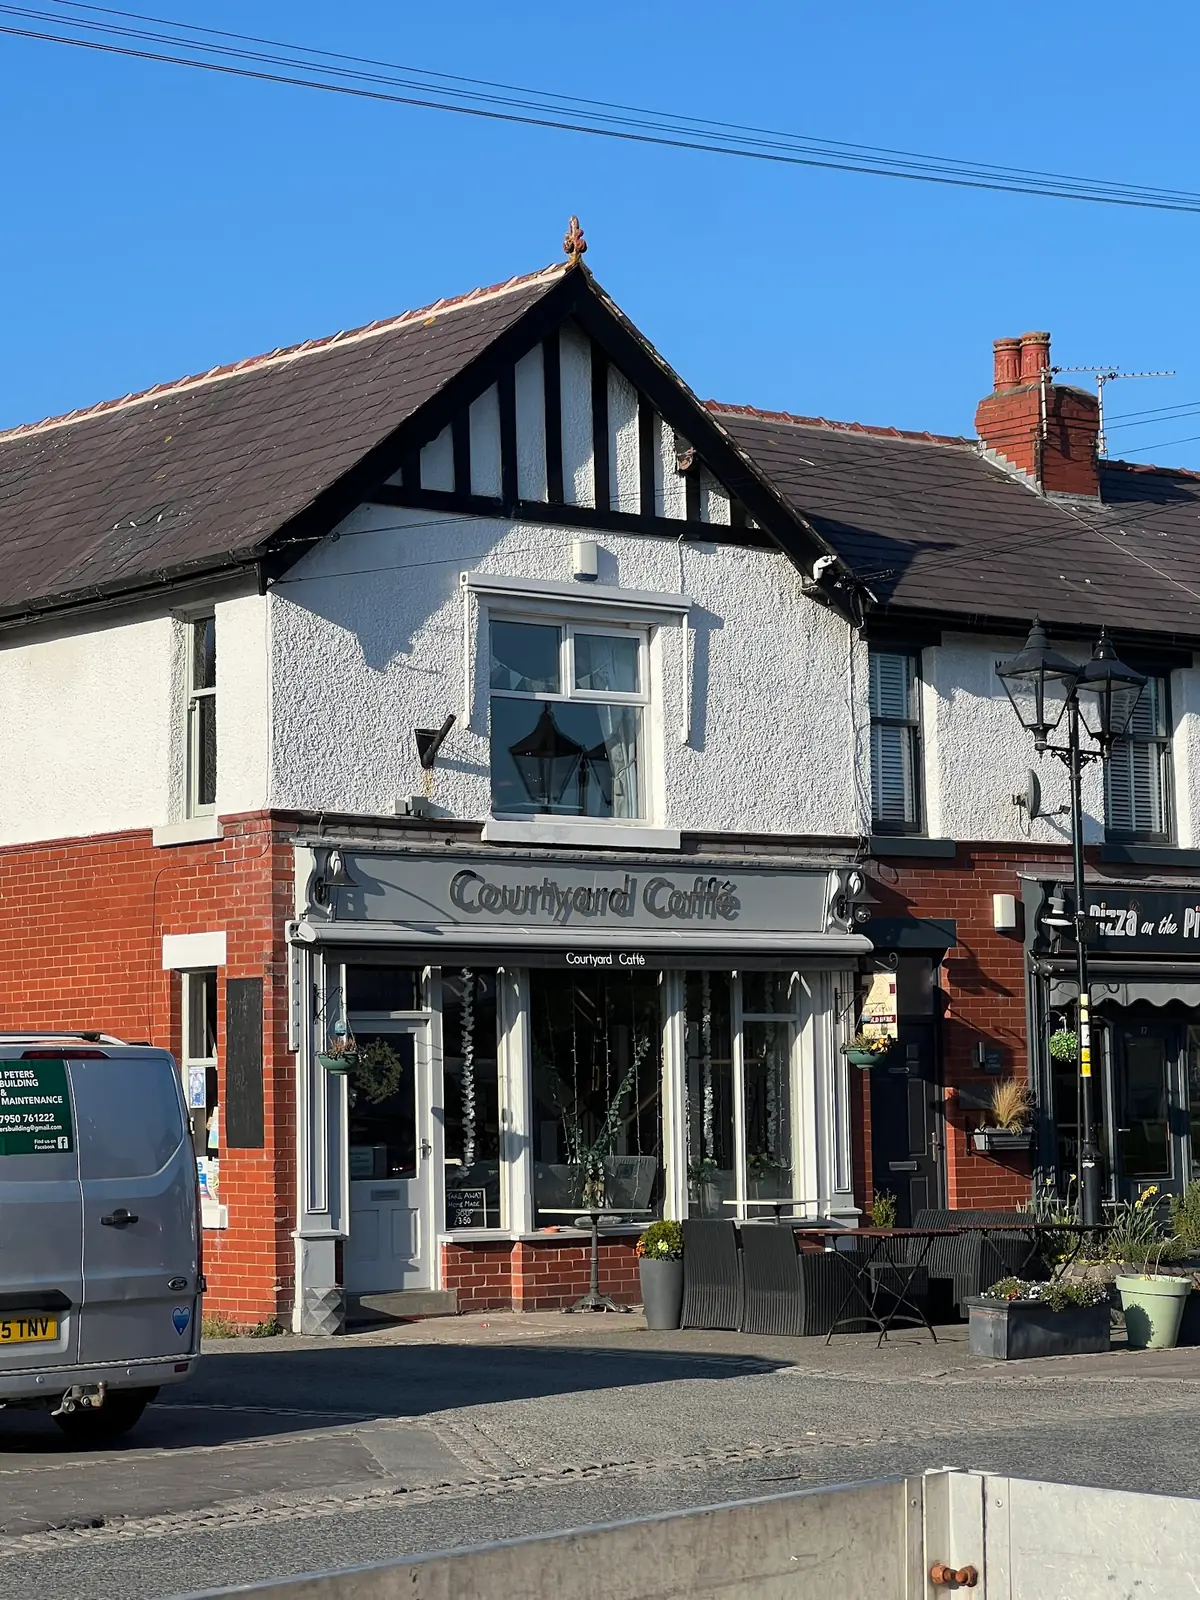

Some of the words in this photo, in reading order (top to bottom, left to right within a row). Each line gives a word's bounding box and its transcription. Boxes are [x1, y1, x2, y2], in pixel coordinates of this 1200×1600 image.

[450, 869, 637, 926] Courtyard
[1141, 921, 1155, 935] on
[1158, 913, 1178, 935] the
[565, 952, 613, 967] Courtyard
[619, 952, 646, 965] Caffé
[4, 1070, 34, 1078] PETERS
[0, 1079, 39, 1088] BUILDING
[1, 1096, 63, 1105] MAINTENANCE
[0, 1115, 21, 1124] 7950
[23, 1113, 54, 1122] 761222
[16, 1318, 49, 1338] TNV
